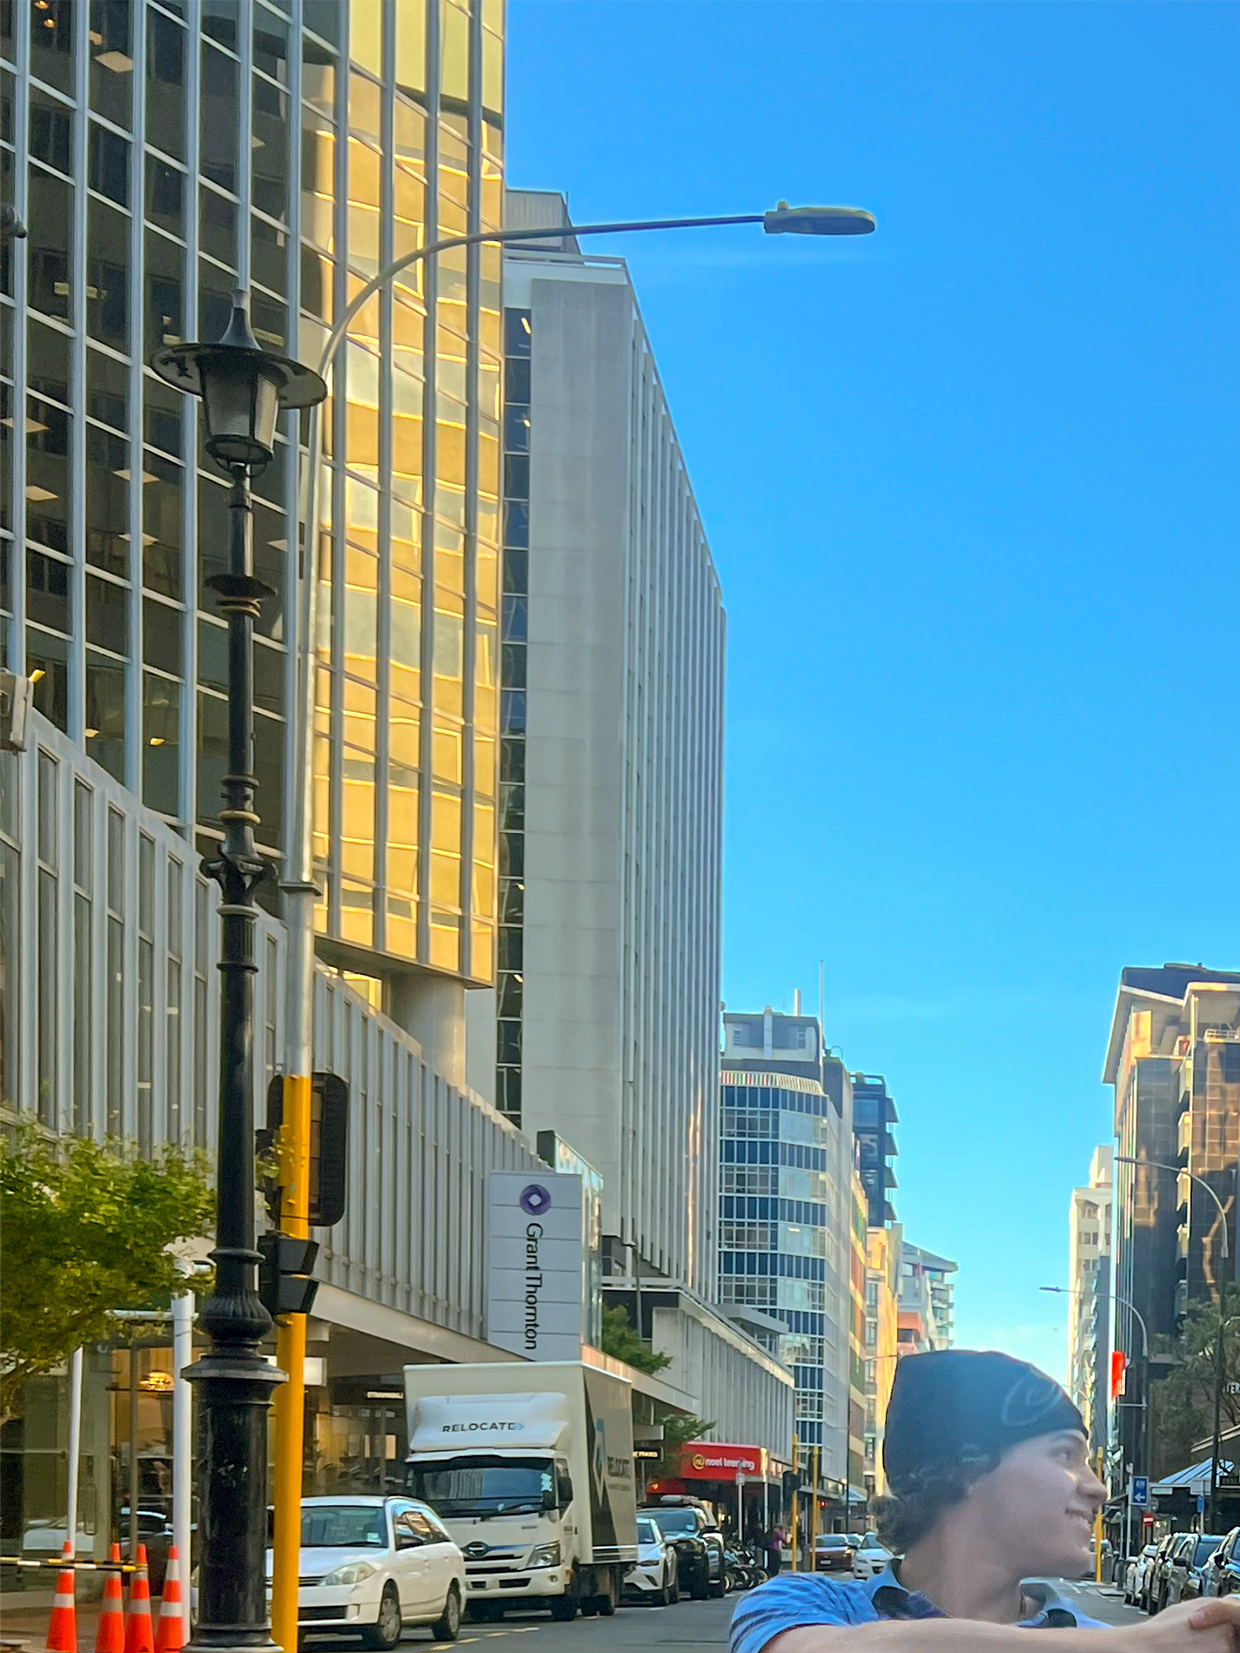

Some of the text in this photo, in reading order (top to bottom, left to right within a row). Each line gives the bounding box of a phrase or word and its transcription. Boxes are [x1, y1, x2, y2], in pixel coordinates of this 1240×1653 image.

[524, 1222, 544, 1350] Grant Thornton
[442, 1422, 516, 1433] RELOCATE
